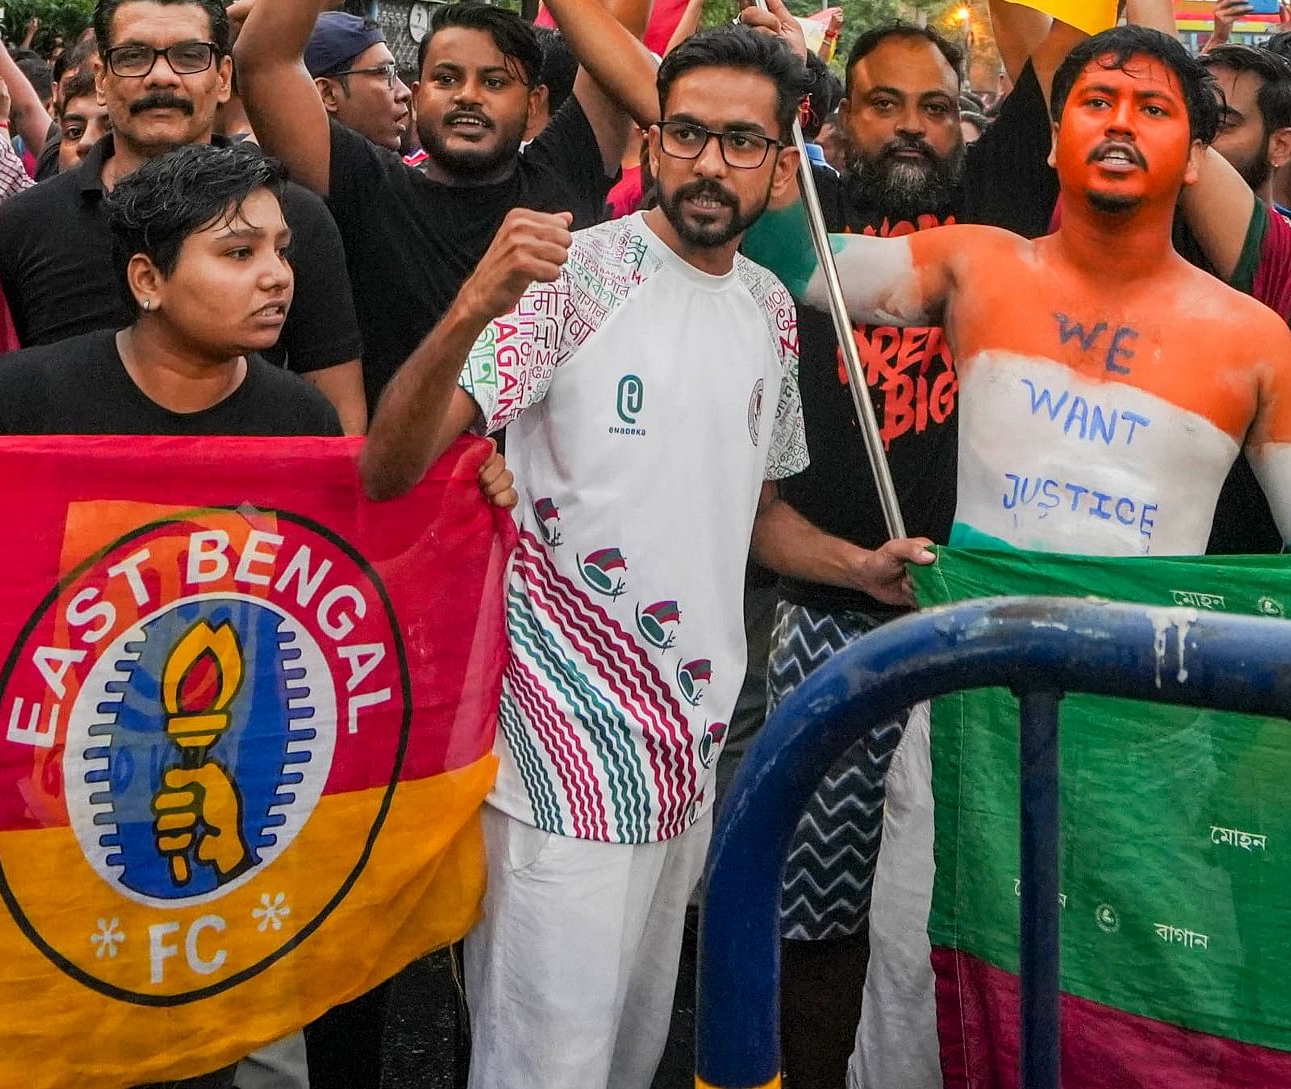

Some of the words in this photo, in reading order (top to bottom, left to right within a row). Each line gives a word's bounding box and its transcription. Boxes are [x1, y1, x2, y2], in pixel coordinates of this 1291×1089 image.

[1053, 312, 1139, 374] WE
[880, 371, 959, 453] BIG
[1021, 378, 1152, 445] WANT
[1002, 472, 1158, 540] JUSTICE
[1169, 589, 1227, 609] মোহন
[5, 546, 153, 749] EAST
[184, 527, 393, 735] BENGAL
[1210, 825, 1267, 852] মোহন
[146, 914, 230, 984] FC
[1153, 922, 1210, 950] বাগান
